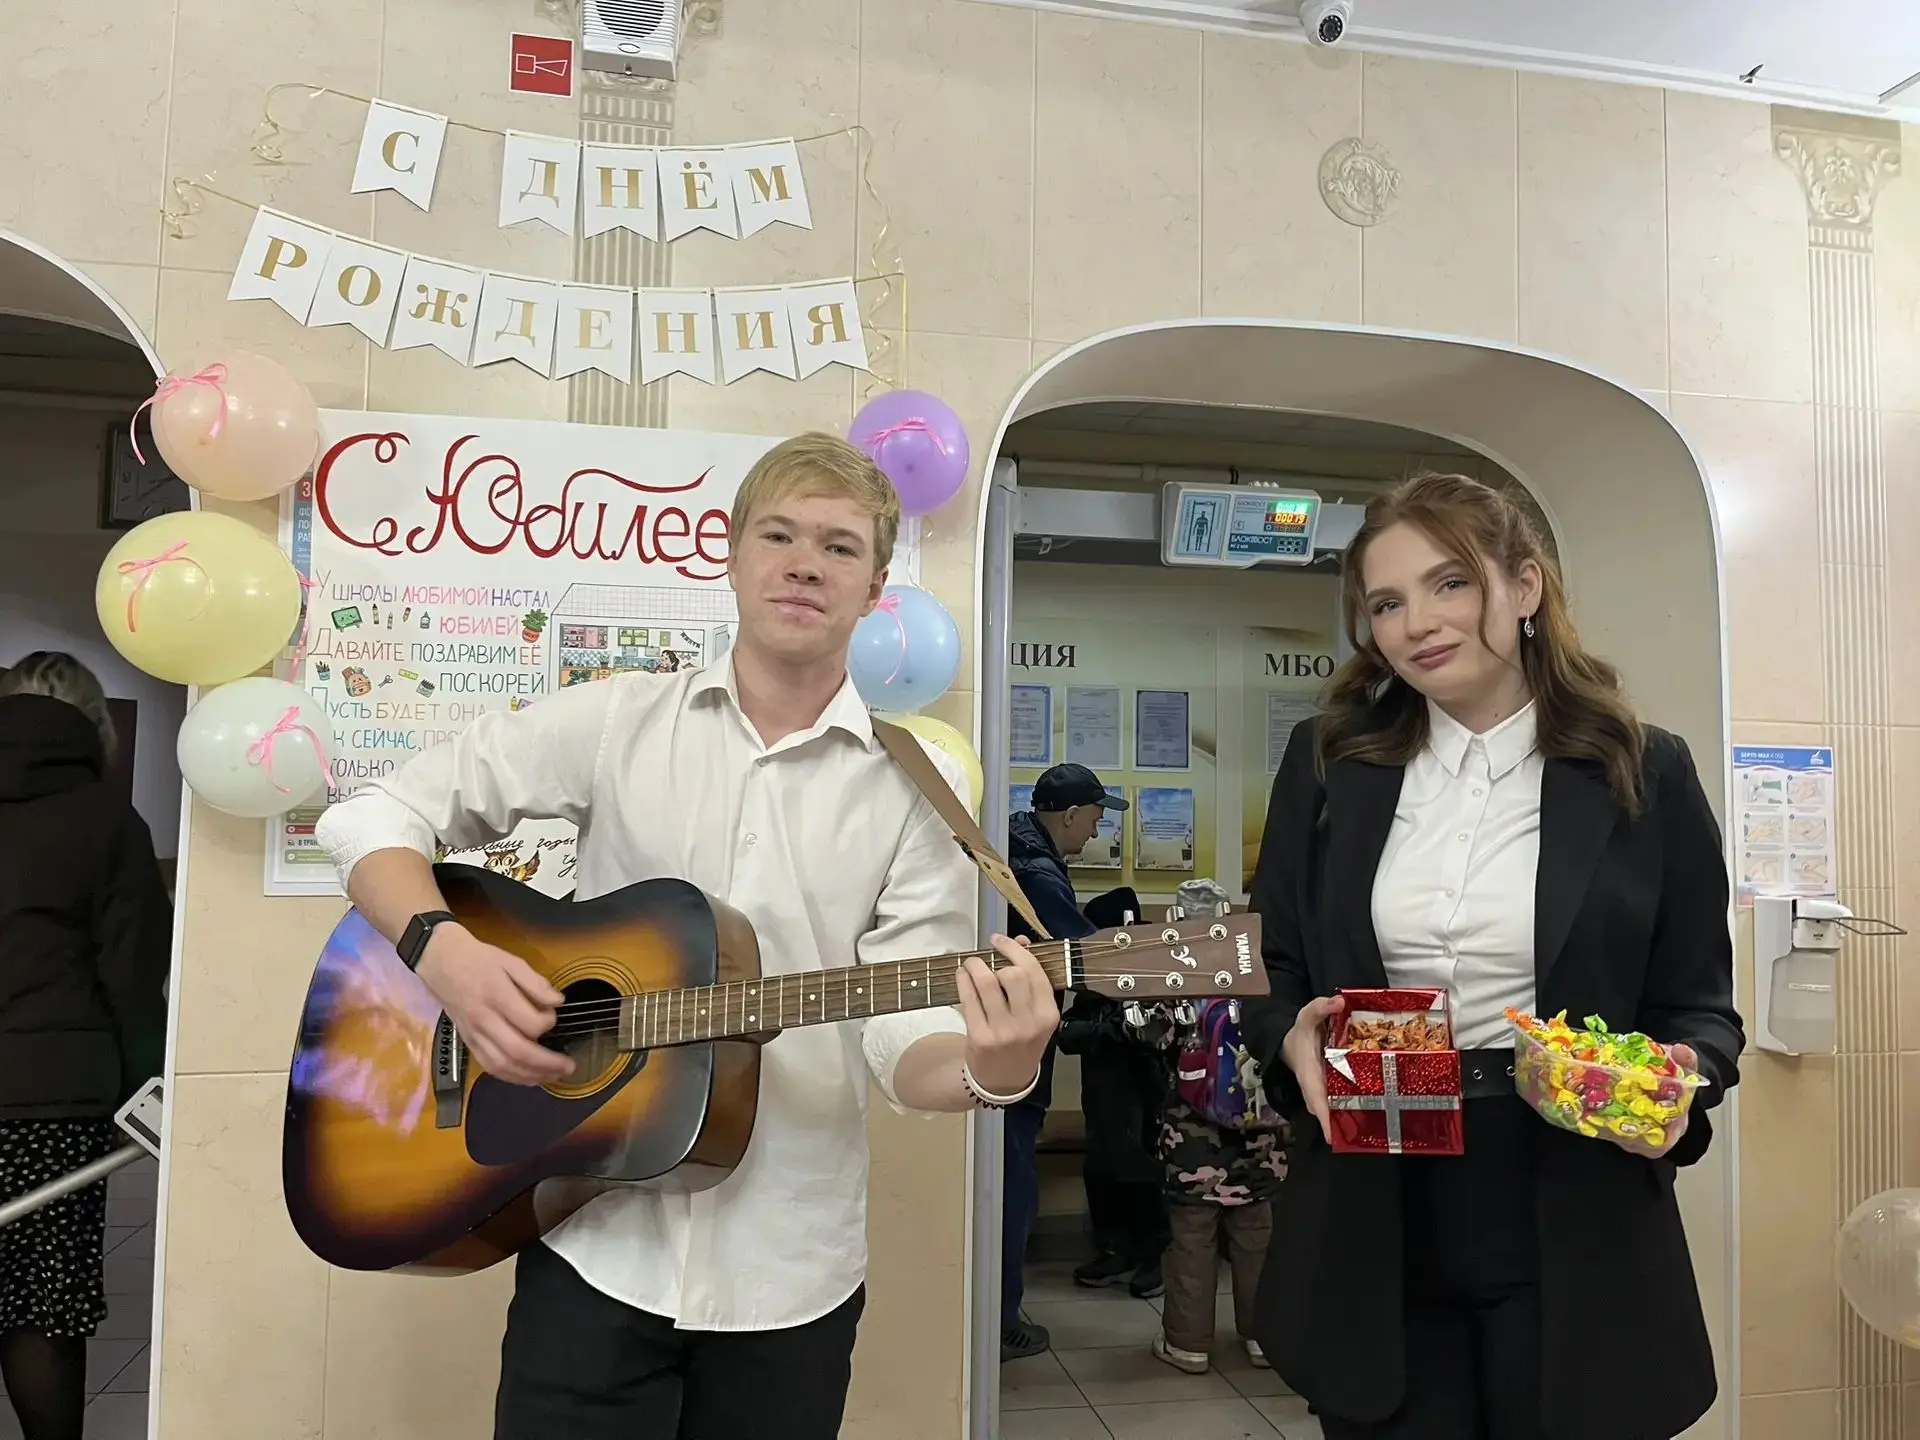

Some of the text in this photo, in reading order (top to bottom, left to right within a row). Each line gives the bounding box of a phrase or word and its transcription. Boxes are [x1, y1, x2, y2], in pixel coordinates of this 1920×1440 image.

[381, 130, 794, 210] С ДНЁМ
[254, 235, 852, 355] РОЖДЕНИЯ
[315, 431, 729, 580] С Юбилее
[316, 569, 550, 608] У ШКОЛЫ ЛЮБИМОЙ НАСТАЛ
[440, 615, 519, 636] ЮБИЛЕЙ
[307, 628, 541, 666] ДАВАЙТЕ ПОЗДРАВИМ ЕЁ
[1011, 642, 1076, 672] ЦИЯ
[440, 672, 544, 694] ПОСКОРЕЙ
[1264, 653, 1335, 679] МБО
[311, 687, 372, 719] ПУСТЬ
[376, 702, 440, 721] БУДЕТ
[352, 728, 422, 752] СЕЙЧАС,
[1235, 932, 1253, 976] YAMAHA
